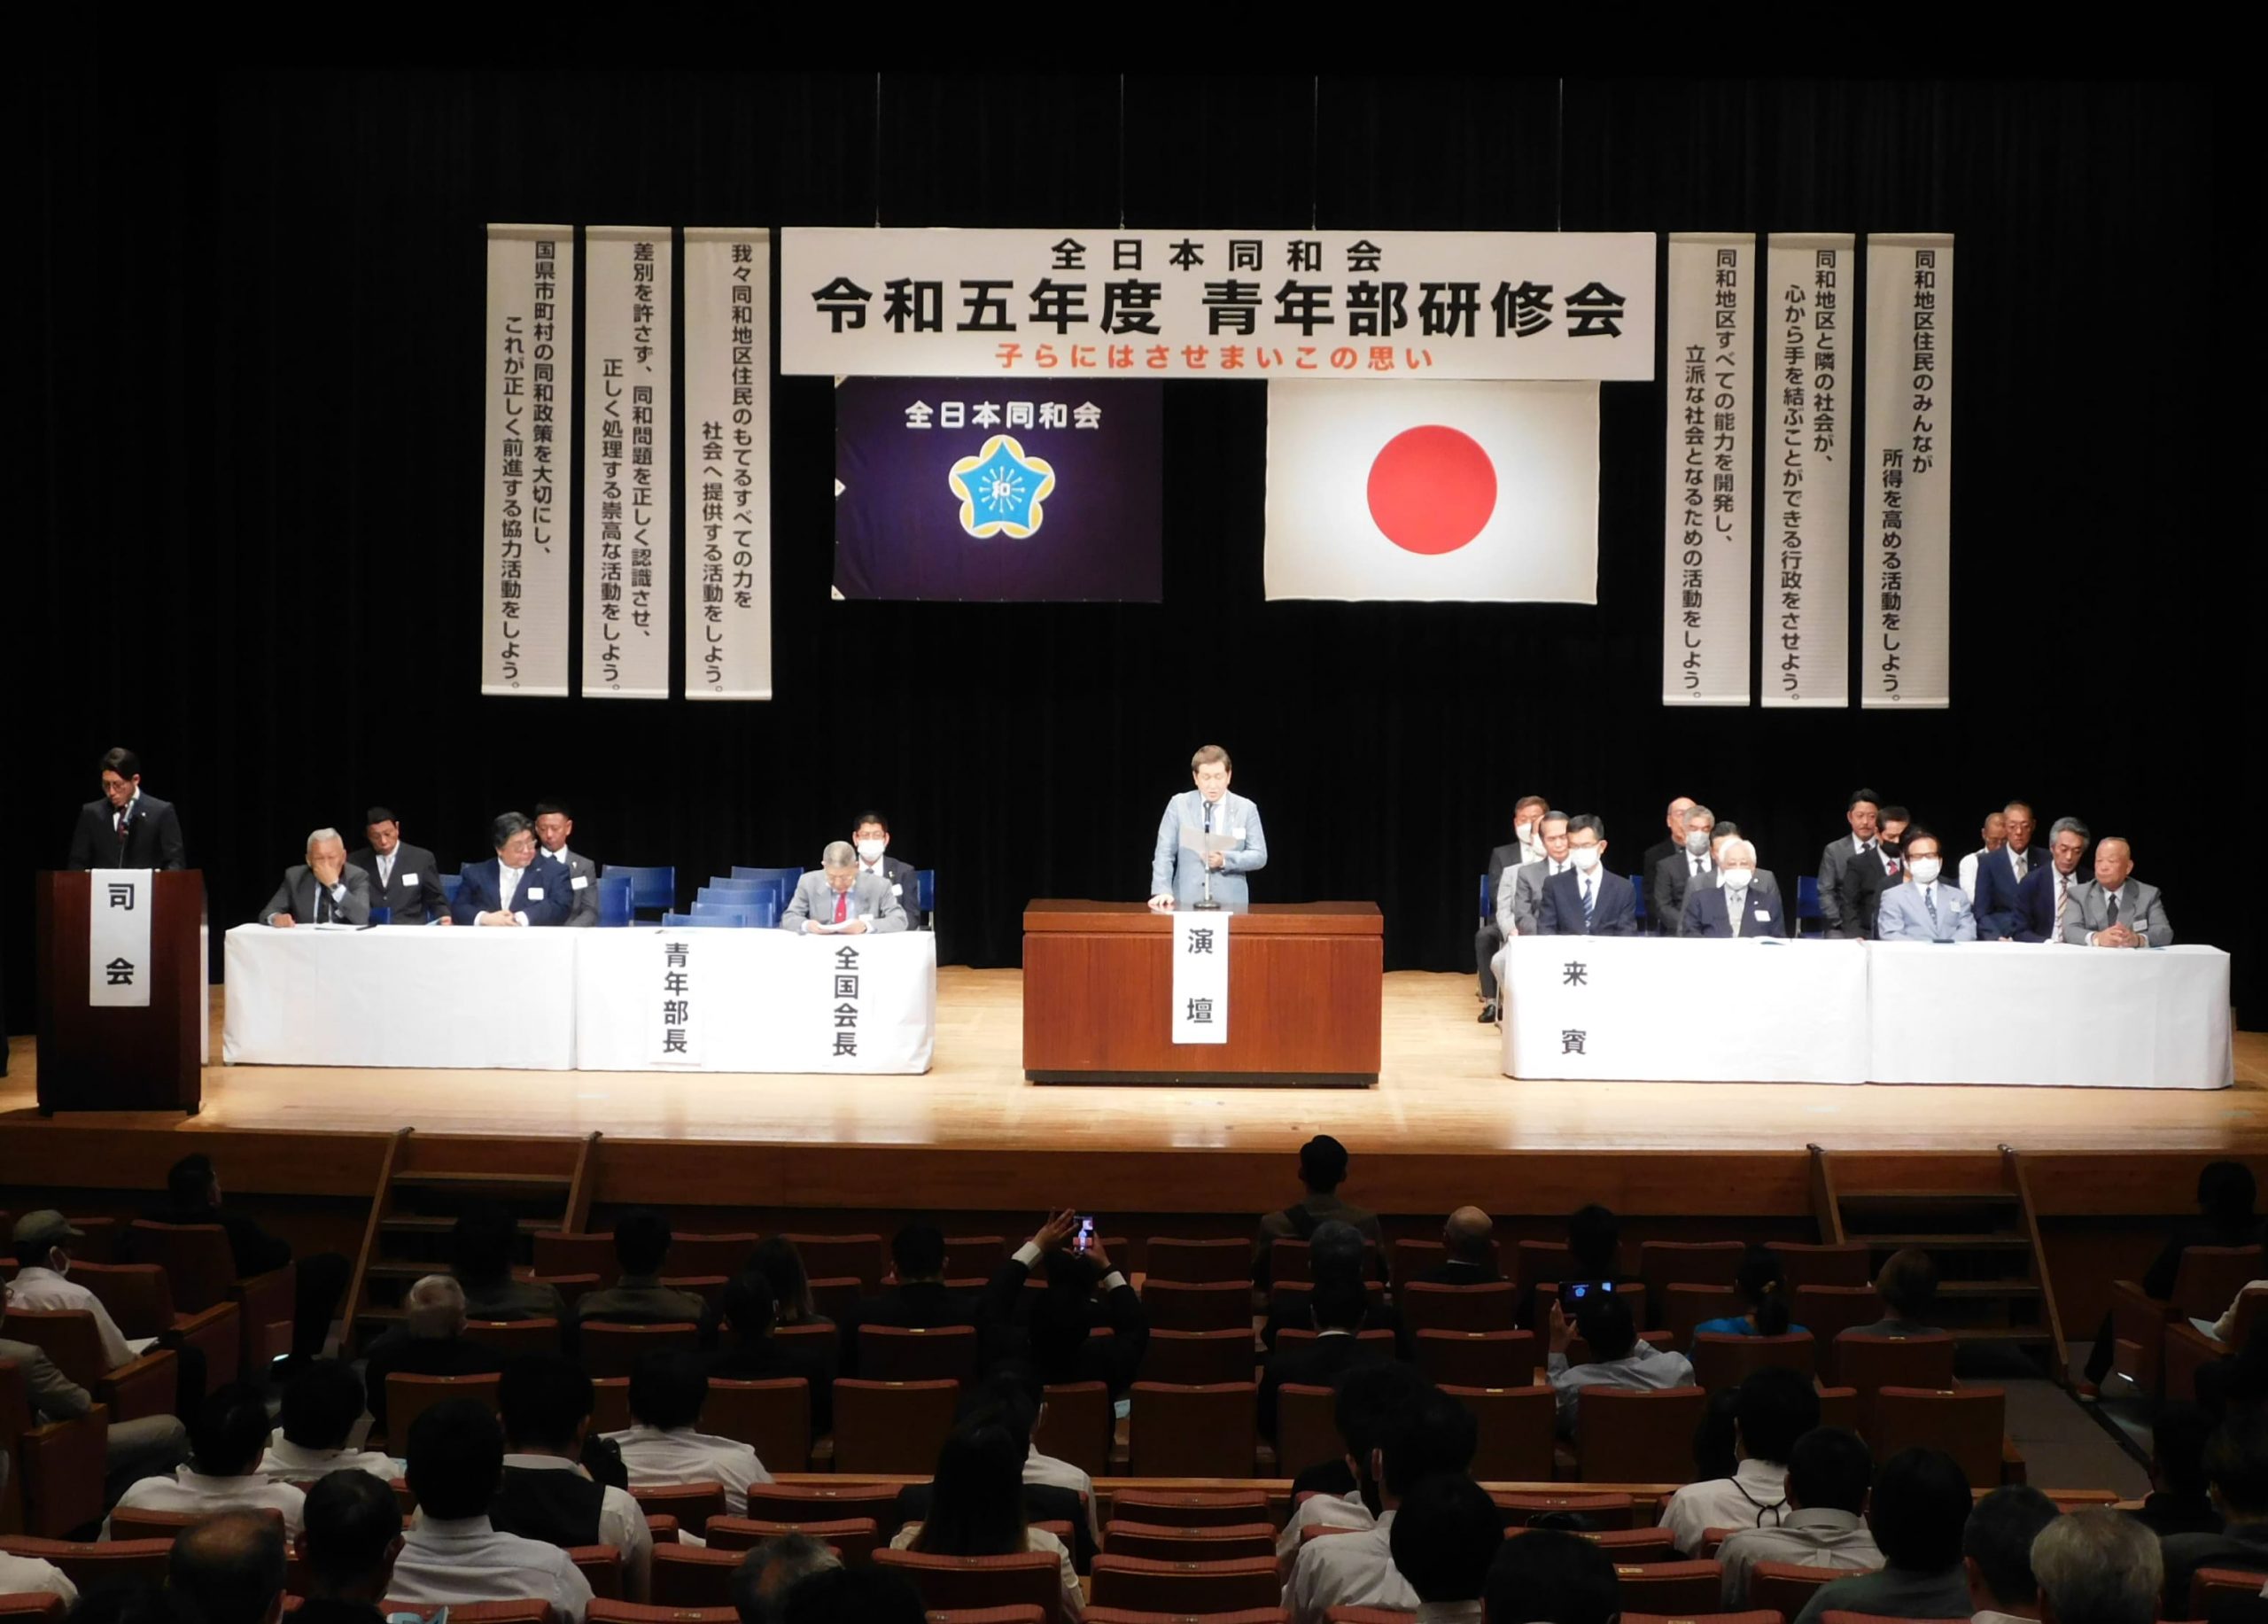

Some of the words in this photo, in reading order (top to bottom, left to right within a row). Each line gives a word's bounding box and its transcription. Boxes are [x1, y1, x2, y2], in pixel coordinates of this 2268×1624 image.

[811, 276, 1162, 336] 令和五年度
[1201, 278, 1627, 338] 青年部研修会
[996, 343, 1433, 370] 子らにはさせまいこの思い
[1051, 236, 1383, 273] 全日本同和会
[1814, 249, 1836, 463] 同和地区と隣の社会が、
[1913, 250, 1935, 474] 同和地区住民のみんなが
[501, 315, 524, 688] これが正しく前進する協力活動をしよう。
[532, 239, 555, 555] 国県市町村の同和政策を大切にし、
[632, 242, 655, 638] 差別を許さず、同和問題を正しく認識させ、
[731, 244, 753, 609] 我々同和地区住民のもてるすべての力を
[904, 401, 1103, 431] 全日本同和会
[1713, 248, 1736, 543] 同和地区すべての能力を開発し、
[1780, 284, 1806, 702] 心から手を結ぶことができる行政をさせよう。
[601, 358, 624, 691] 正しく処理する崇高な活動をしよう。
[701, 422, 724, 693] 社会へ提供する活動をしよう。
[1682, 344, 1706, 699] 立派な社会となるための活動をしよう。
[1881, 449, 1903, 702] 所得を高める活動をしよう。
[106, 882, 135, 985] 司会
[662, 942, 689, 1054] 青年部長
[832, 945, 858, 1057] 全国会長
[1186, 928, 1213, 1024] 演壇
[1561, 960, 1588, 1055] 来賓
